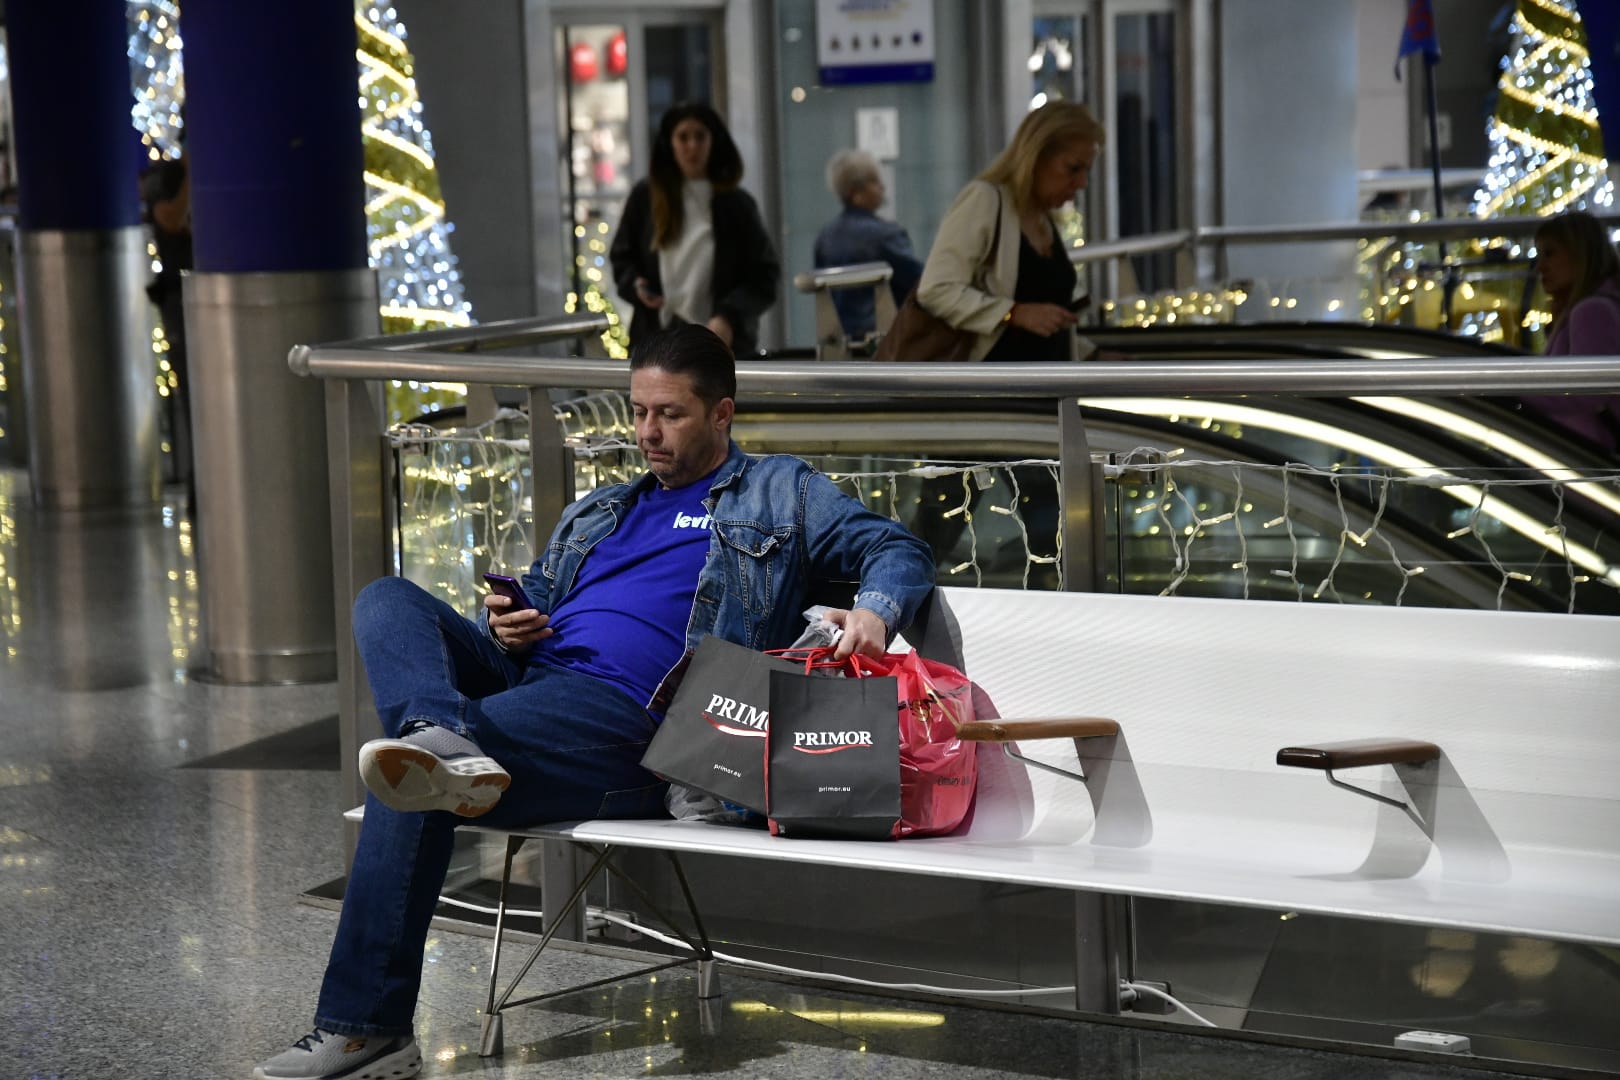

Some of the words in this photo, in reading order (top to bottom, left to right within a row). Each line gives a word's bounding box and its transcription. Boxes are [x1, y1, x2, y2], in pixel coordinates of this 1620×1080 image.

[673, 511, 713, 530] levi
[705, 693, 769, 731] PRIM
[794, 731, 873, 746] PRIMOR
[714, 763, 742, 778] primor.eu
